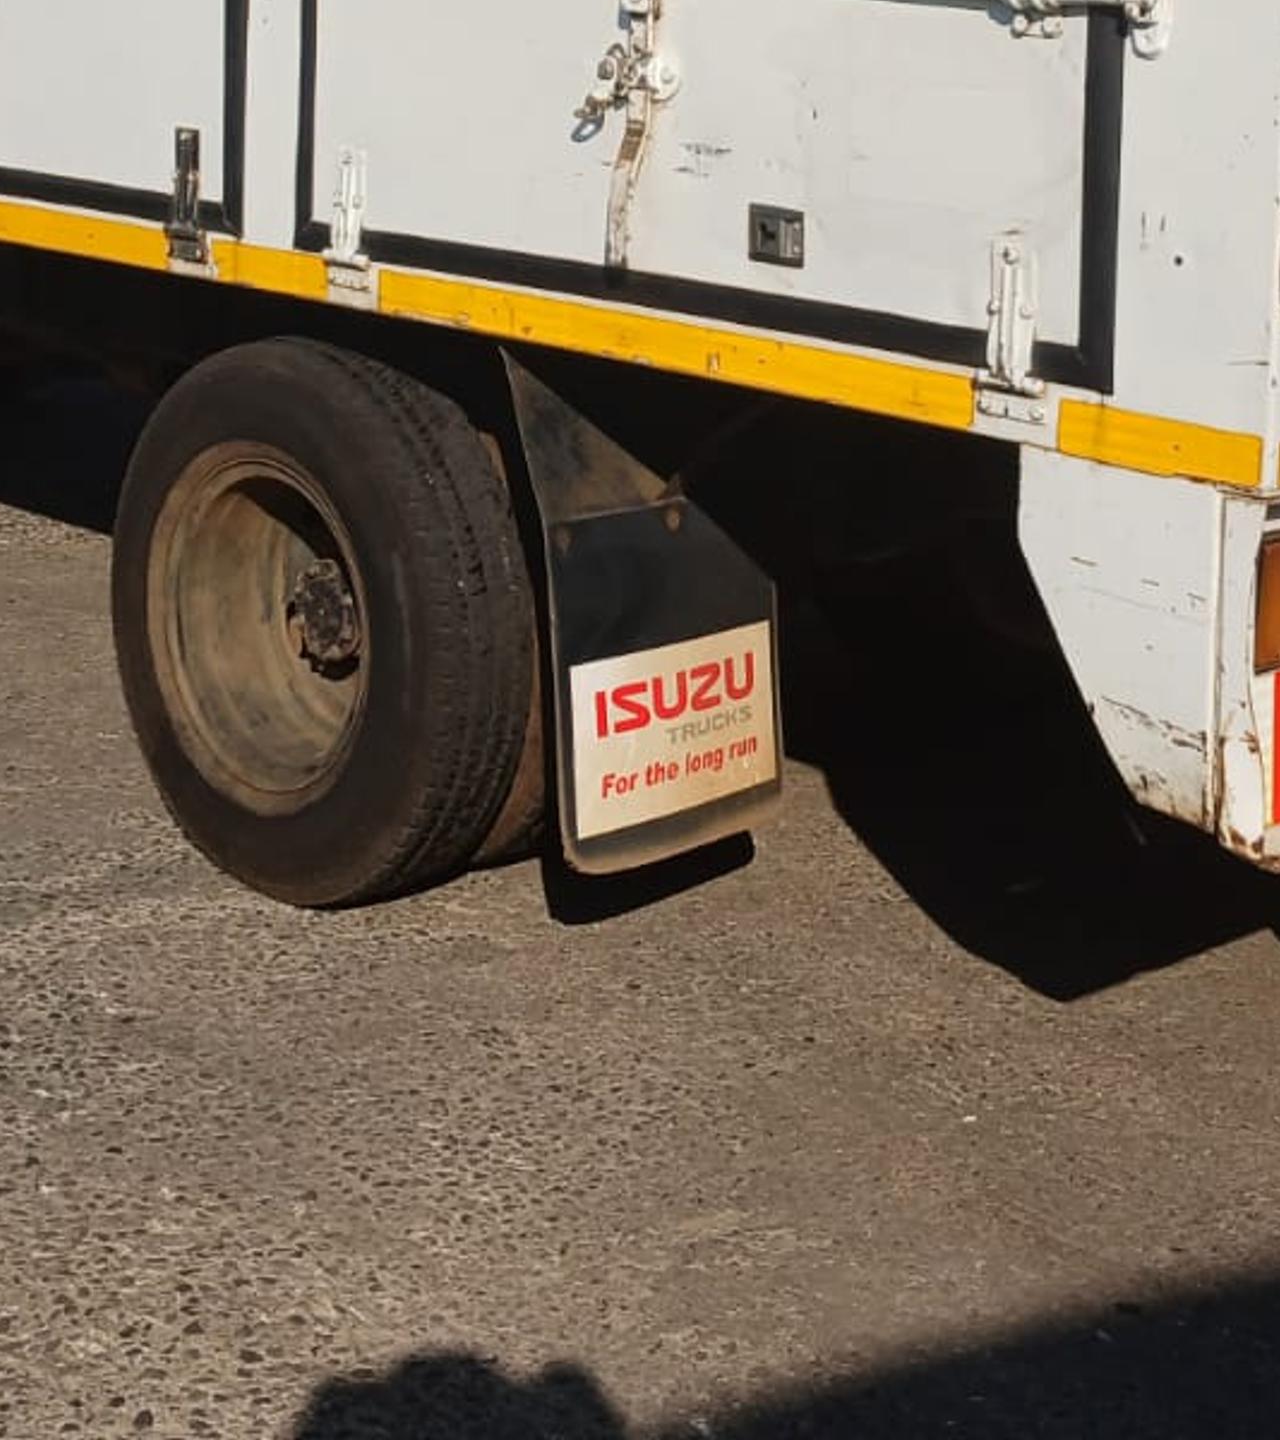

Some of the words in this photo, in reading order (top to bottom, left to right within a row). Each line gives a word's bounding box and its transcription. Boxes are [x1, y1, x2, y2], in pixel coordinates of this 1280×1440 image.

[595, 652, 755, 739] ISUZU
[665, 704, 753, 745] TRUCKS
[601, 771, 639, 799] For
[645, 760, 679, 787] the
[685, 747, 724, 777] long
[729, 736, 758, 760] run
